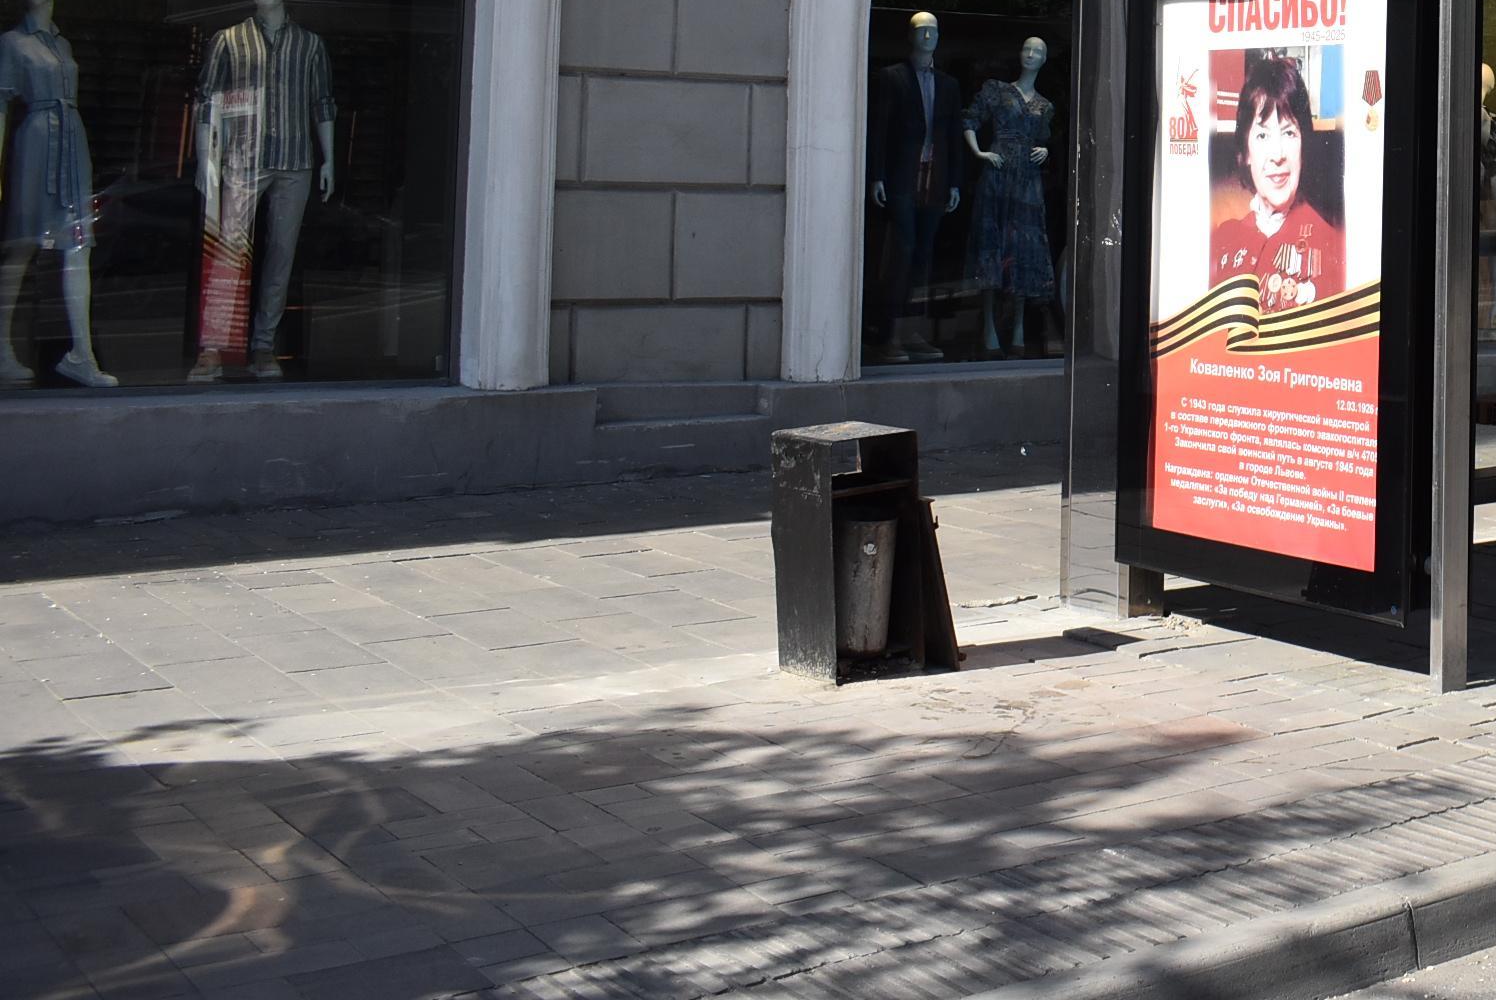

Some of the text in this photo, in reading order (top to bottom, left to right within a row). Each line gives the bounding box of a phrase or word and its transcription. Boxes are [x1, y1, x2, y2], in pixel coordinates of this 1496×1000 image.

[1169, 116, 1185, 139] 80
[1169, 143, 1199, 157] ПОБЕДА!
[1189, 357, 1363, 393] Коваленко Зоя Григорьевна
[1181, 397, 1370, 433] С 1943 года служила хирургической медсестрой
[1336, 399, 1374, 415] 12.03.1926
[1164, 421, 1179, 433] 1-го
[1180, 423, 1228, 440] Украинского
[1230, 431, 1262, 446] фронта,
[1263, 437, 1302, 450] являлась
[1303, 443, 1346, 458] комсоргом
[1170, 410, 1176, 420] в
[1177, 411, 1209, 424] составе
[1210, 415, 1266, 433] передвижного
[1267, 422, 1315, 438] фронтового
[1174, 436, 1374, 478] Закончила свой воинский путь в августе 1945 года
[1238, 461, 1307, 480] в городе Львове.
[1164, 461, 1213, 479] Награждена:
[1215, 472, 1249, 485] орденом
[1250, 475, 1311, 496] Отечественной
[1312, 487, 1338, 500] войны
[1229, 487, 1258, 501] победу
[1259, 492, 1275, 504] над
[1341, 505, 1374, 521] боевые
[1246, 505, 1305, 523] освобождение
